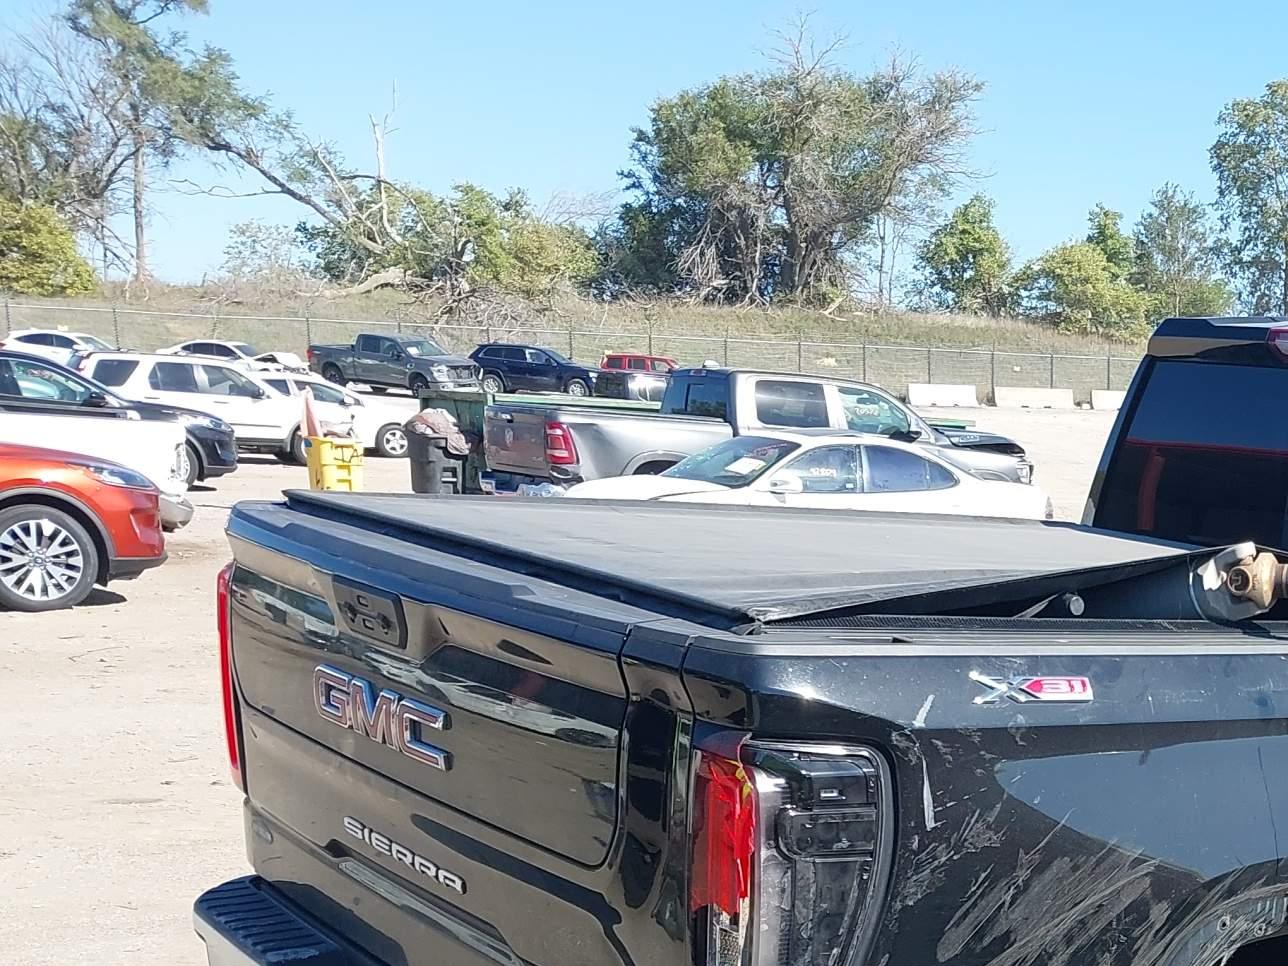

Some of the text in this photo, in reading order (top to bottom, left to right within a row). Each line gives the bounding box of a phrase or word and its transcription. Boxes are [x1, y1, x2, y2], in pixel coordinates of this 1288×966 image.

[313, 664, 453, 773] GMC
[968, 671, 1095, 704] X31
[343, 815, 467, 895] SIERRA
